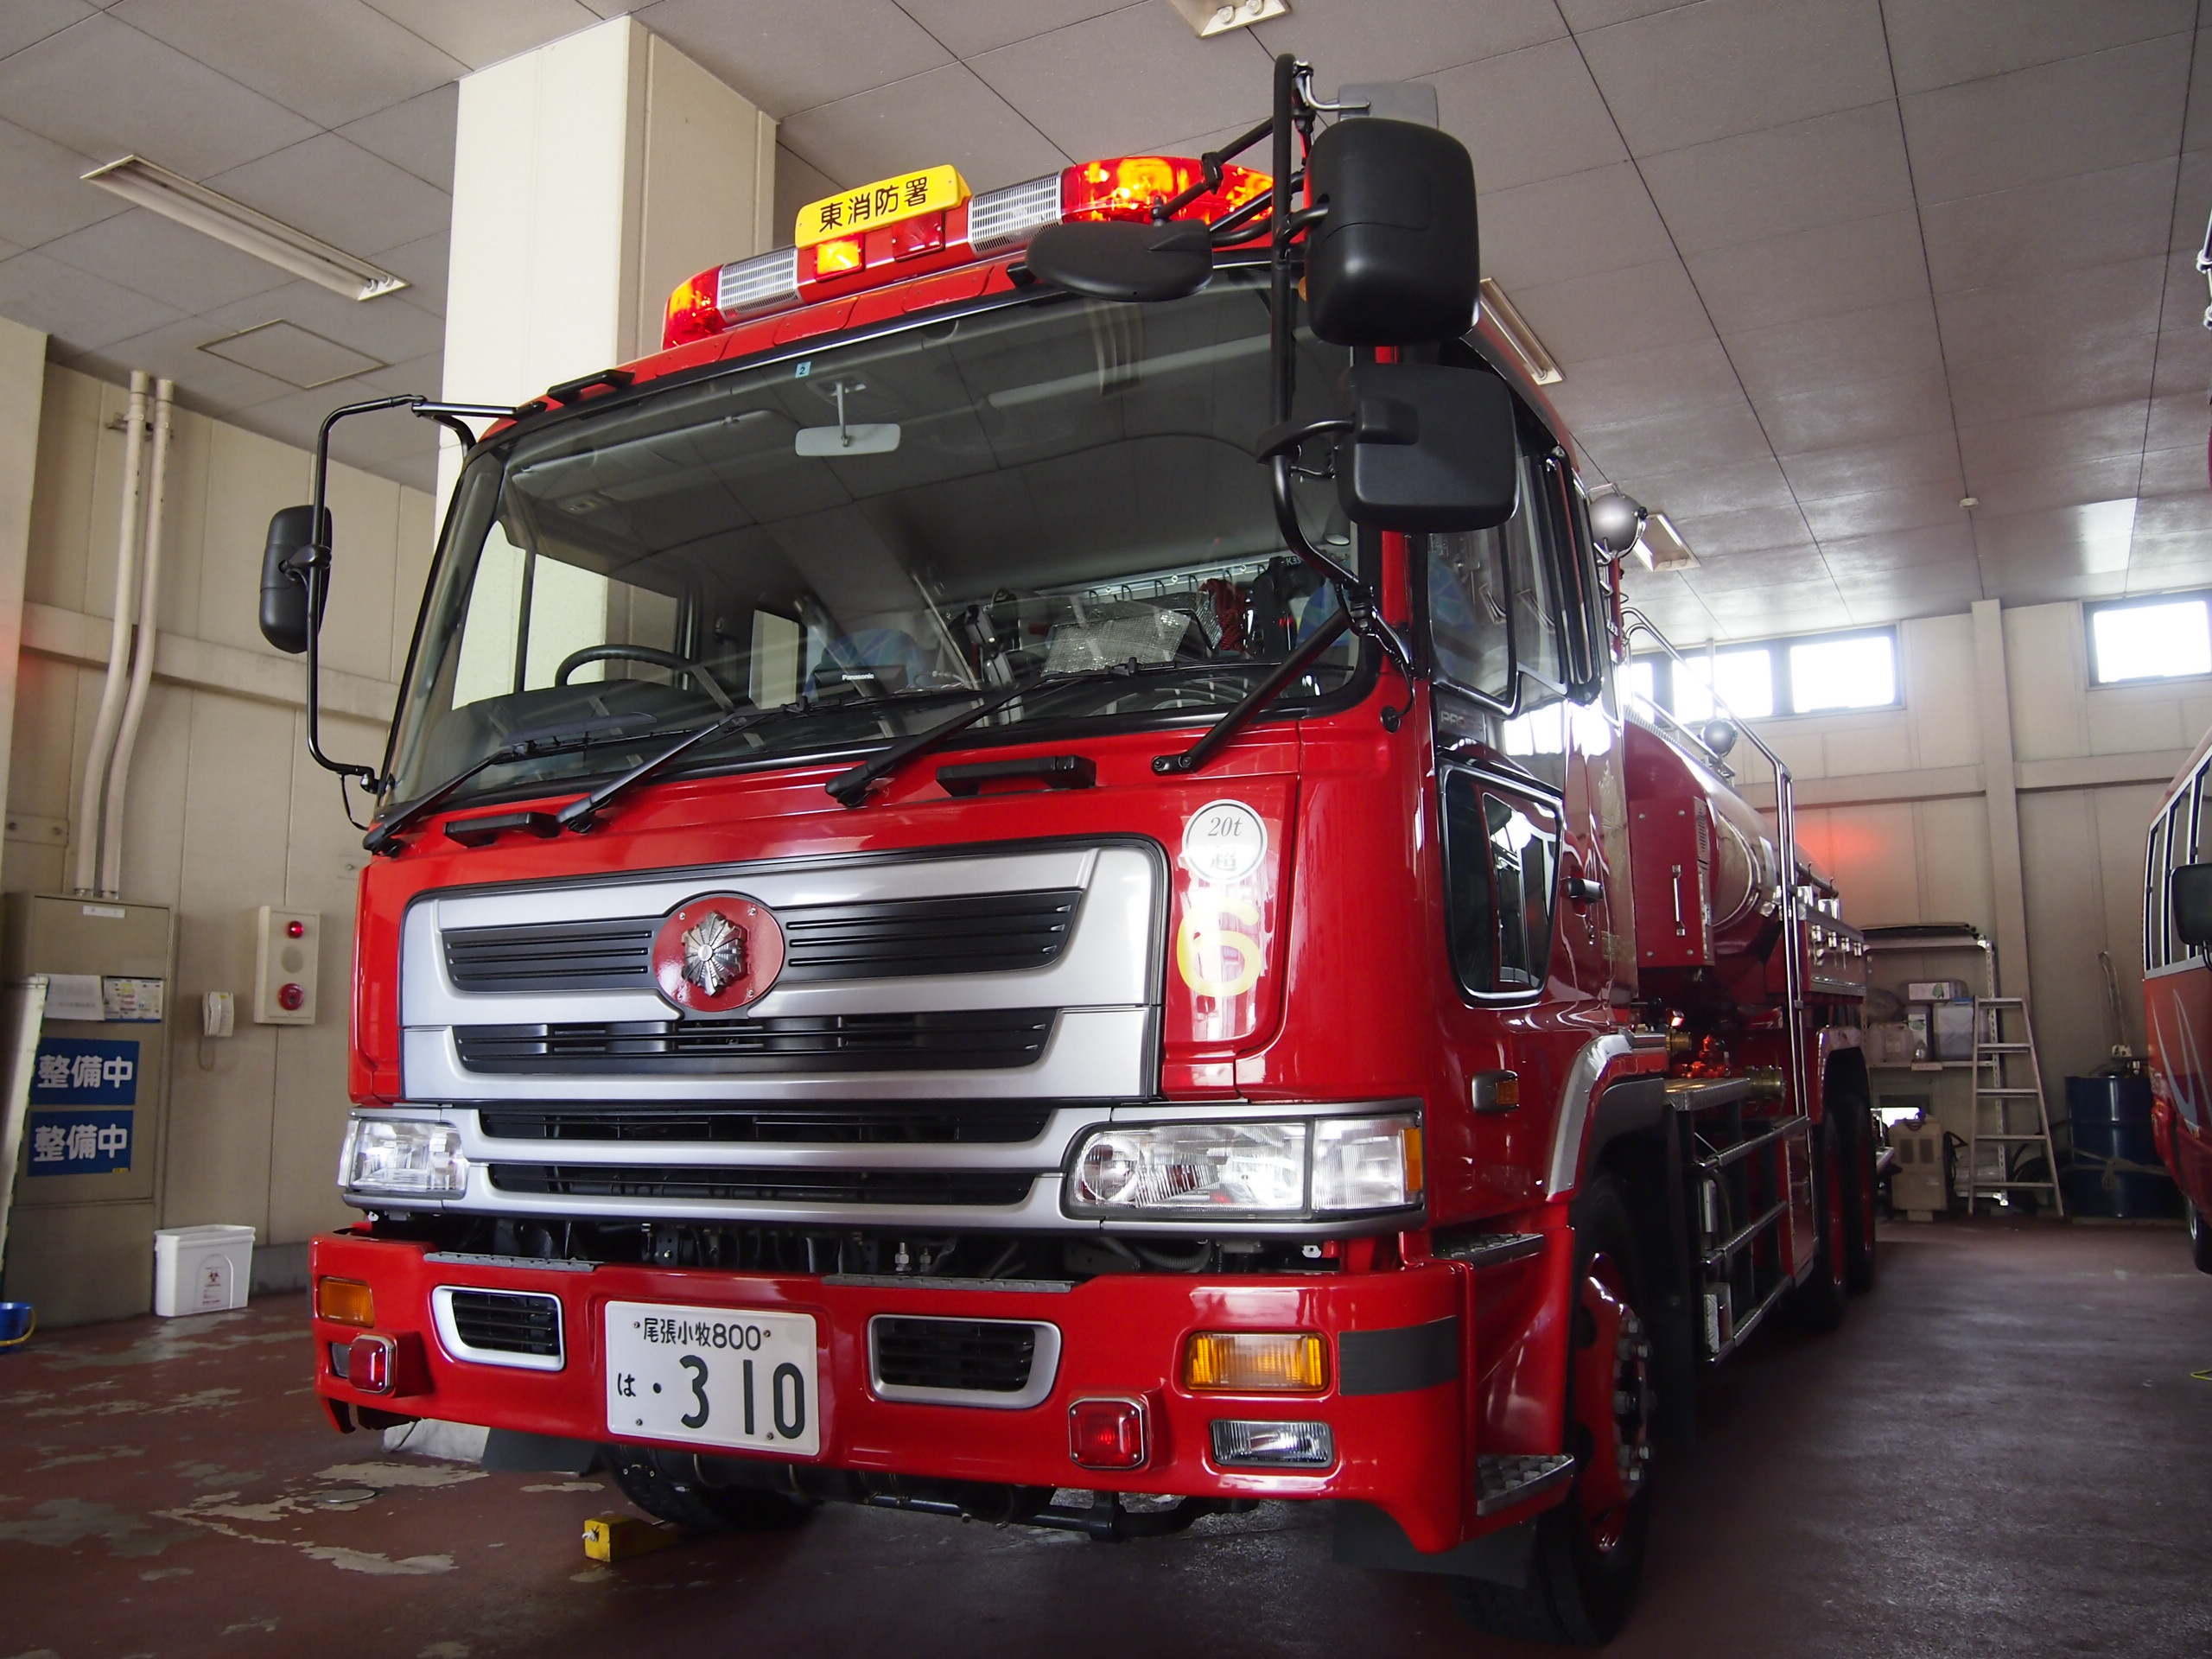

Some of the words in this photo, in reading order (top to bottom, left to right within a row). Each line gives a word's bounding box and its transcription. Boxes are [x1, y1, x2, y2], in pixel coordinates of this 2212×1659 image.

[819, 176, 928, 232] 東消防署
[799, 366, 805, 375] 2
[842, 672, 874, 681] Panasonic
[1207, 817, 1243, 836] 20t
[1177, 898, 1262, 997] 6
[37, 1054, 133, 1089] 整備中
[33, 1123, 128, 1162] 整備中
[617, 1372, 636, 1397] は
